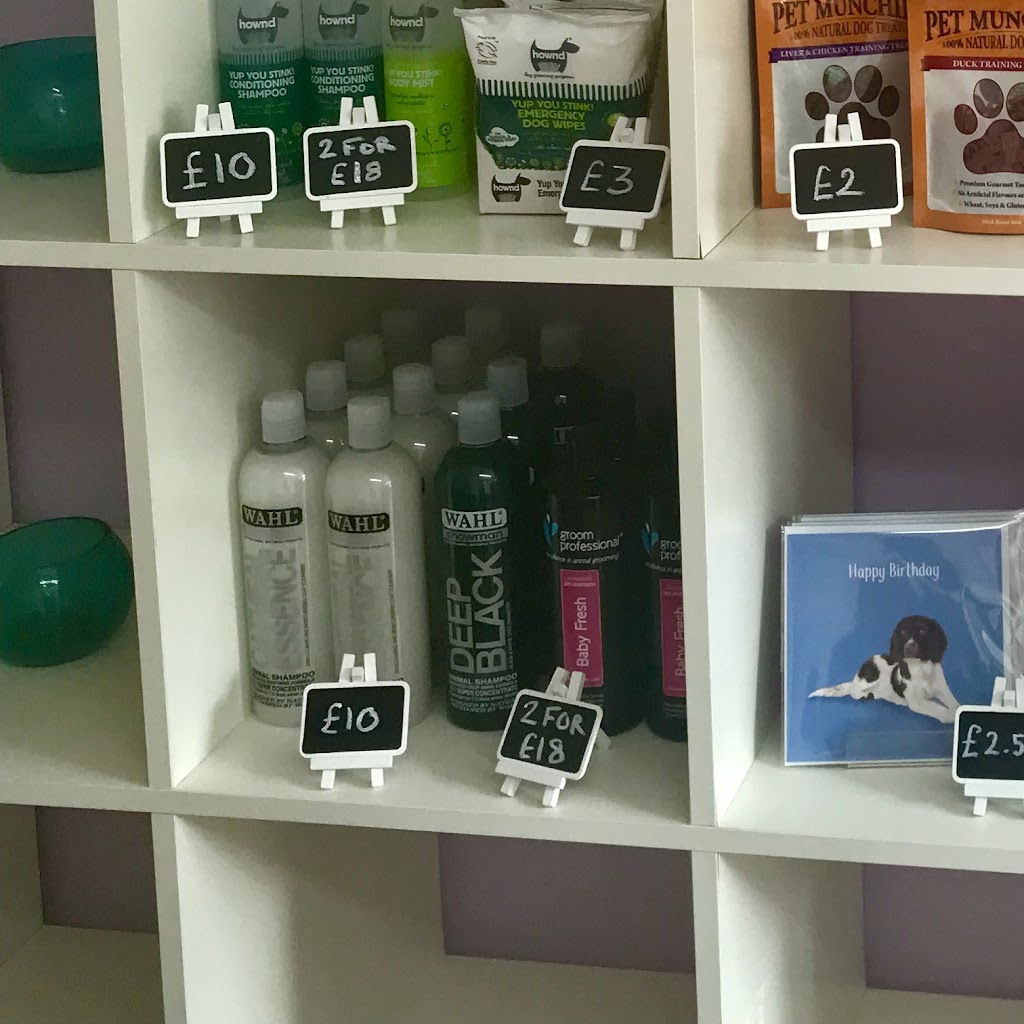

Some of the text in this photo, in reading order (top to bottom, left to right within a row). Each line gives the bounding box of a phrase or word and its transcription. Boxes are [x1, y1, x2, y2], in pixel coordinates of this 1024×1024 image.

[239, 16, 276, 30] hownd
[319, 14, 355, 26] hownd
[389, 16, 424, 27] hownd
[772, 0, 810, 35] PET
[812, 22, 852, 38] NATURAL
[853, 21, 873, 34] DOG
[924, 10, 964, 42] PET
[942, 38, 963, 49] 100%
[965, 36, 1008, 50] NATURAL
[532, 49, 566, 60] hownd
[780, 49, 805, 58] LIVER
[812, 46, 850, 56] CHICKEN
[851, 43, 889, 53] TRAINING
[310, 64, 374, 76] YUP YOU STINK!
[952, 60, 978, 68] DUCK
[980, 60, 1023, 69] TRAINING
[229, 67, 295, 80] YUP YOU STINK!
[310, 73, 375, 85] CONDITIONING
[229, 76, 295, 89] CONDITIONING
[318, 84, 366, 94] SHAMPOO
[237, 88, 287, 99] SHAMPOO
[511, 100, 594, 111] YUP YOU STINK!
[518, 109, 586, 121] EMERGENCY
[522, 119, 586, 131] DOG WIPES
[319, 136, 397, 159] 2 FOR
[183, 150, 256, 190] £10
[331, 160, 383, 186] £18
[536, 179, 566, 189] Yup Yo
[580, 160, 635, 195] £3
[813, 164, 865, 201] £2
[493, 184, 520, 192] hownd
[244, 506, 300, 526] WAHL
[445, 512, 503, 528] WAHL
[331, 515, 386, 532] WAHL
[560, 530, 594, 541] groom
[560, 536, 620, 552] professional
[661, 540, 681, 550] groo
[848, 562, 940, 582] Happy Birthday
[471, 549, 507, 674] BLACK
[574, 597, 587, 631] Fresh
[446, 577, 475, 674] DEEP
[576, 635, 591, 667] Baby
[272, 671, 315, 681] SHAMPOO
[475, 673, 518, 685] SHAMPOO
[321, 702, 379, 735] £10
[519, 701, 540, 724] 2
[542, 706, 587, 736] FOR
[519, 733, 567, 765] £18
